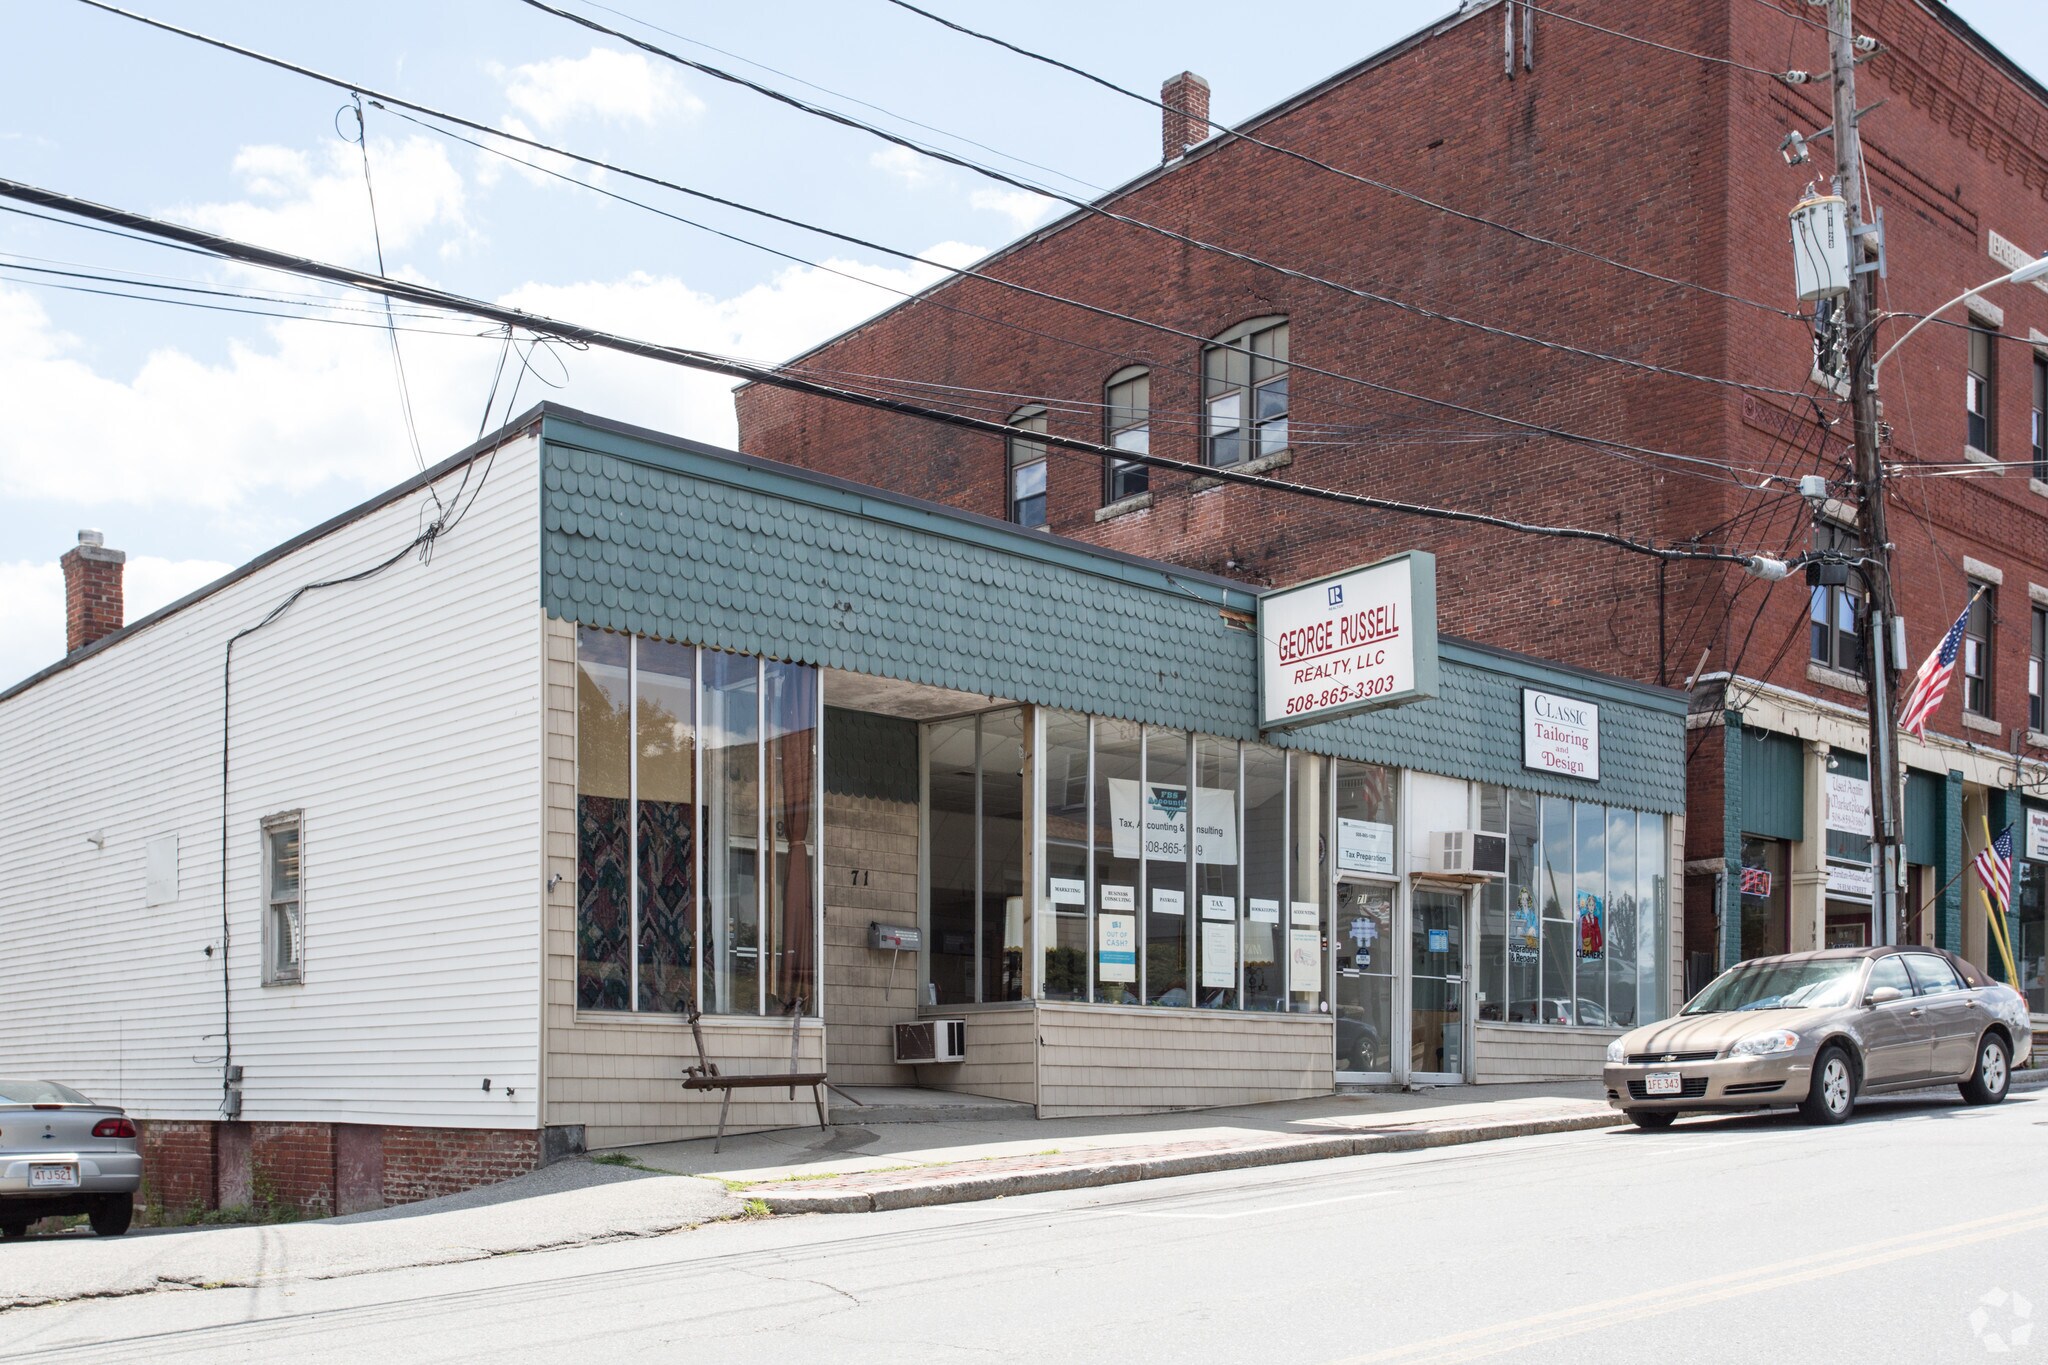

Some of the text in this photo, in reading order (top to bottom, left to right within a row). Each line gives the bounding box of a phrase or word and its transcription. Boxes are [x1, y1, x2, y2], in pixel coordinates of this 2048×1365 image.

[1278, 603, 1399, 661] GEORGE RUSSELL
[1294, 650, 1385, 685] REALTY, LLC
[1286, 674, 1394, 715] 508-865-3303
[1534, 694, 1588, 727] CLASSIC
[1534, 722, 1589, 750] Tailoring
[1555, 746, 1569, 754] and
[1541, 751, 1584, 774] Design
[1119, 818, 1135, 829] Tax,
[1180, 824, 1185, 832] &
[1196, 826, 1223, 837] nsulting
[1345, 850, 1387, 862] Tax Preparation
[851, 870, 868, 886] 71
[1508, 943, 1539, 955] Alterations
[1576, 948, 1604, 960] CLEANERS
[1516, 954, 1537, 963] Repairs
[1648, 1079, 1679, 1090] 1FE 343
[35, 1170, 72, 1180] 4TJ 521
